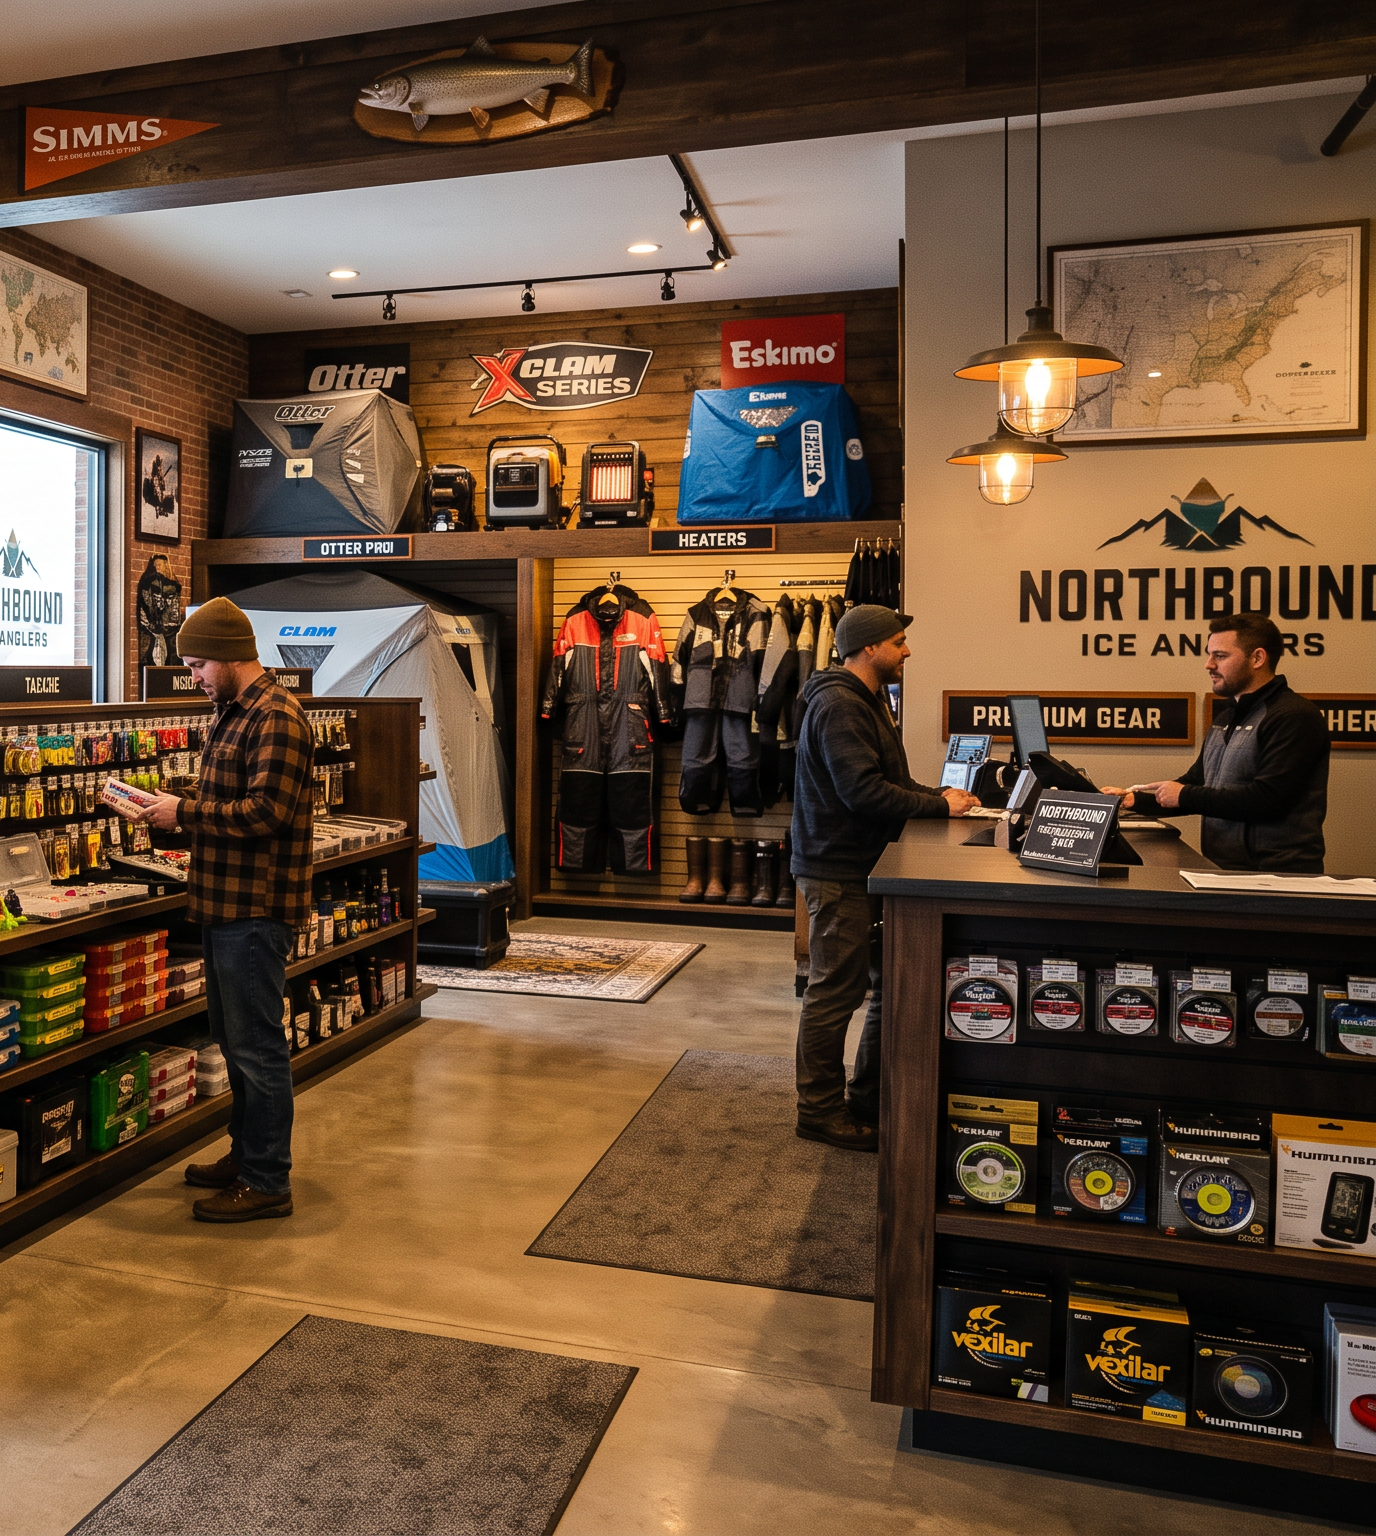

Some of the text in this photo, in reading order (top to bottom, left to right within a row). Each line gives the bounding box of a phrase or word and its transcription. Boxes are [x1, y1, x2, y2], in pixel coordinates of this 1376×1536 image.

[32, 118, 162, 153] SIMMS
[729, 338, 835, 369] Eskimo
[308, 363, 406, 392] Otter
[519, 354, 617, 379] CLAM
[536, 377, 631, 396] SERIES
[320, 542, 362, 556] OTTER
[678, 532, 747, 547] HEATERS
[278, 626, 337, 637] CLAM
[1082, 632, 1325, 657] ICE ANRS
[973, 706, 1161, 729] PREIUM GEAR
[1205, 1416, 1303, 1439] HUMMINBIRD
